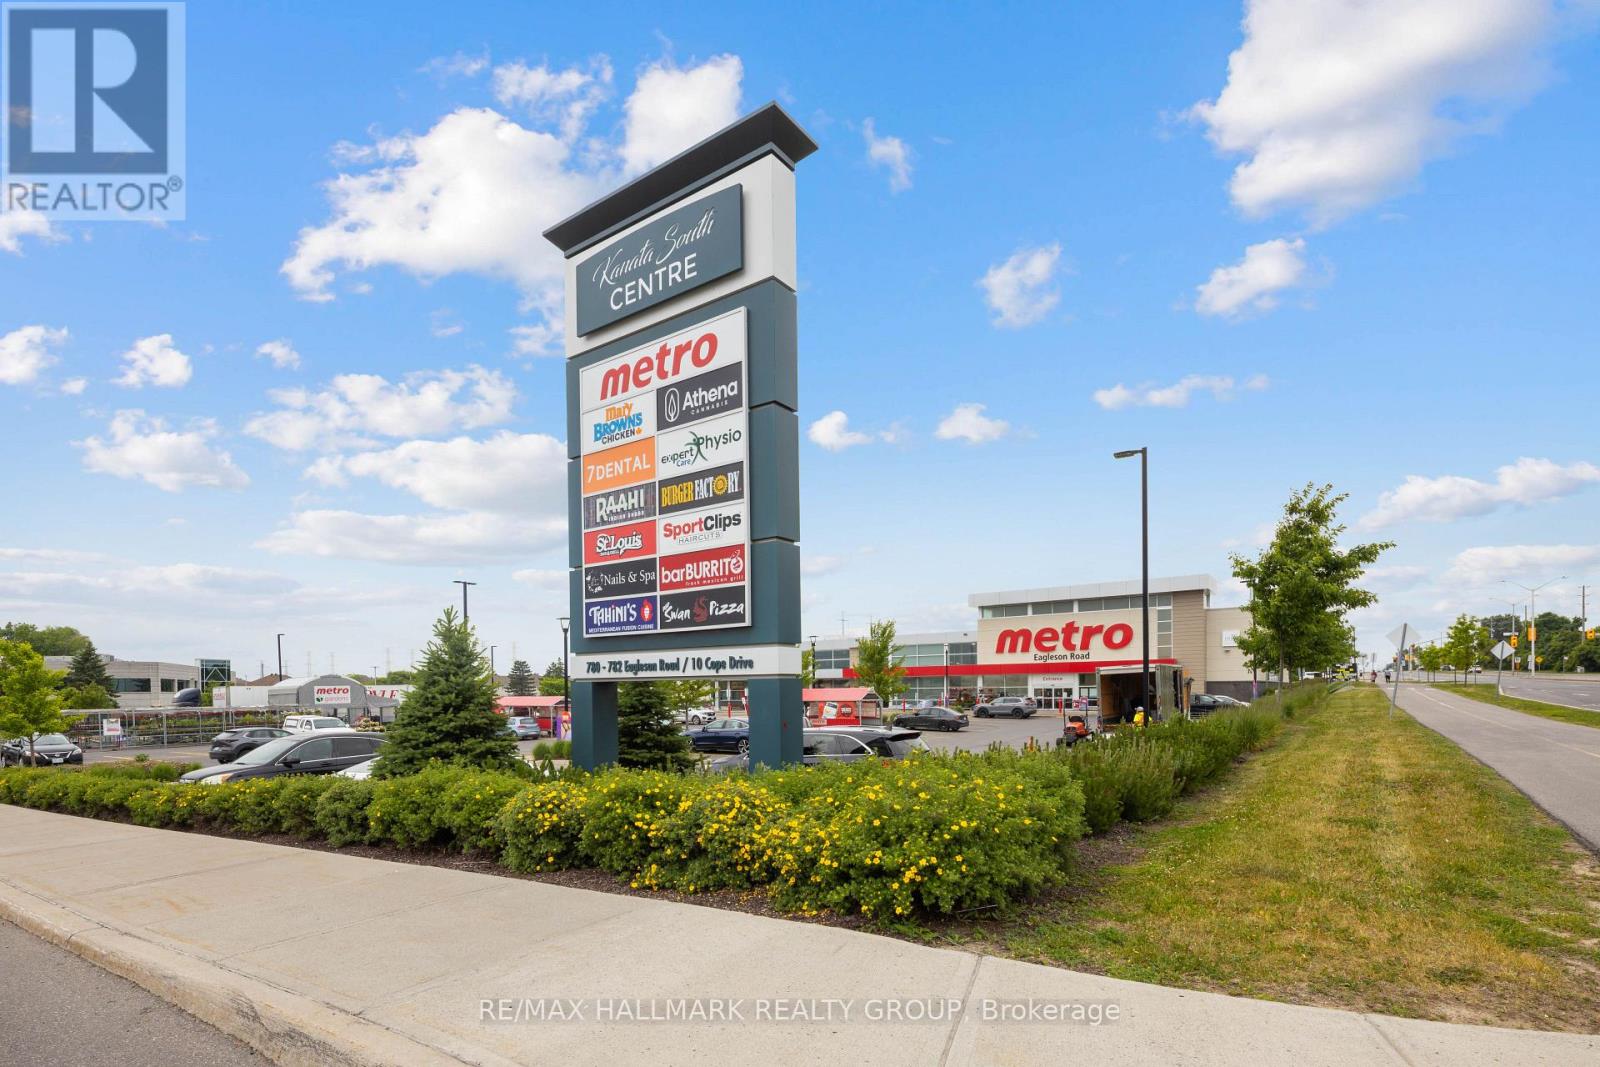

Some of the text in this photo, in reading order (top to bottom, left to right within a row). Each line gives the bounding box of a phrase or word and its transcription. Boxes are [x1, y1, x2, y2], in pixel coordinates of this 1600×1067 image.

[592, 206, 716, 289] Kanata South
[610, 252, 698, 311] CENTRE
[600, 332, 718, 401] metro
[682, 380, 738, 411] Athena
[593, 412, 643, 443] BROWNS
[601, 427, 636, 445] CHICKEN
[586, 453, 651, 484] 7DENTAL
[676, 458, 692, 468] Care
[661, 470, 741, 508] BURGER FACTORY
[596, 489, 645, 523] RAAHI
[678, 531, 722, 545] HAIRCUTS
[603, 571, 626, 586] Nails
[628, 571, 638, 583] &
[639, 569, 656, 585] Spa
[709, 600, 744, 616] Pizza
[995, 620, 1134, 654] metro
[624, 659, 657, 676] Eagleson
[659, 657, 680, 673] Road
[682, 656, 689, 673] /
[691, 657, 703, 671] 10
[704, 656, 727, 674] Cope
[728, 655, 754, 670] Drive
[1033, 651, 1090, 662] Eagleson Road
[316, 687, 349, 695] metro
